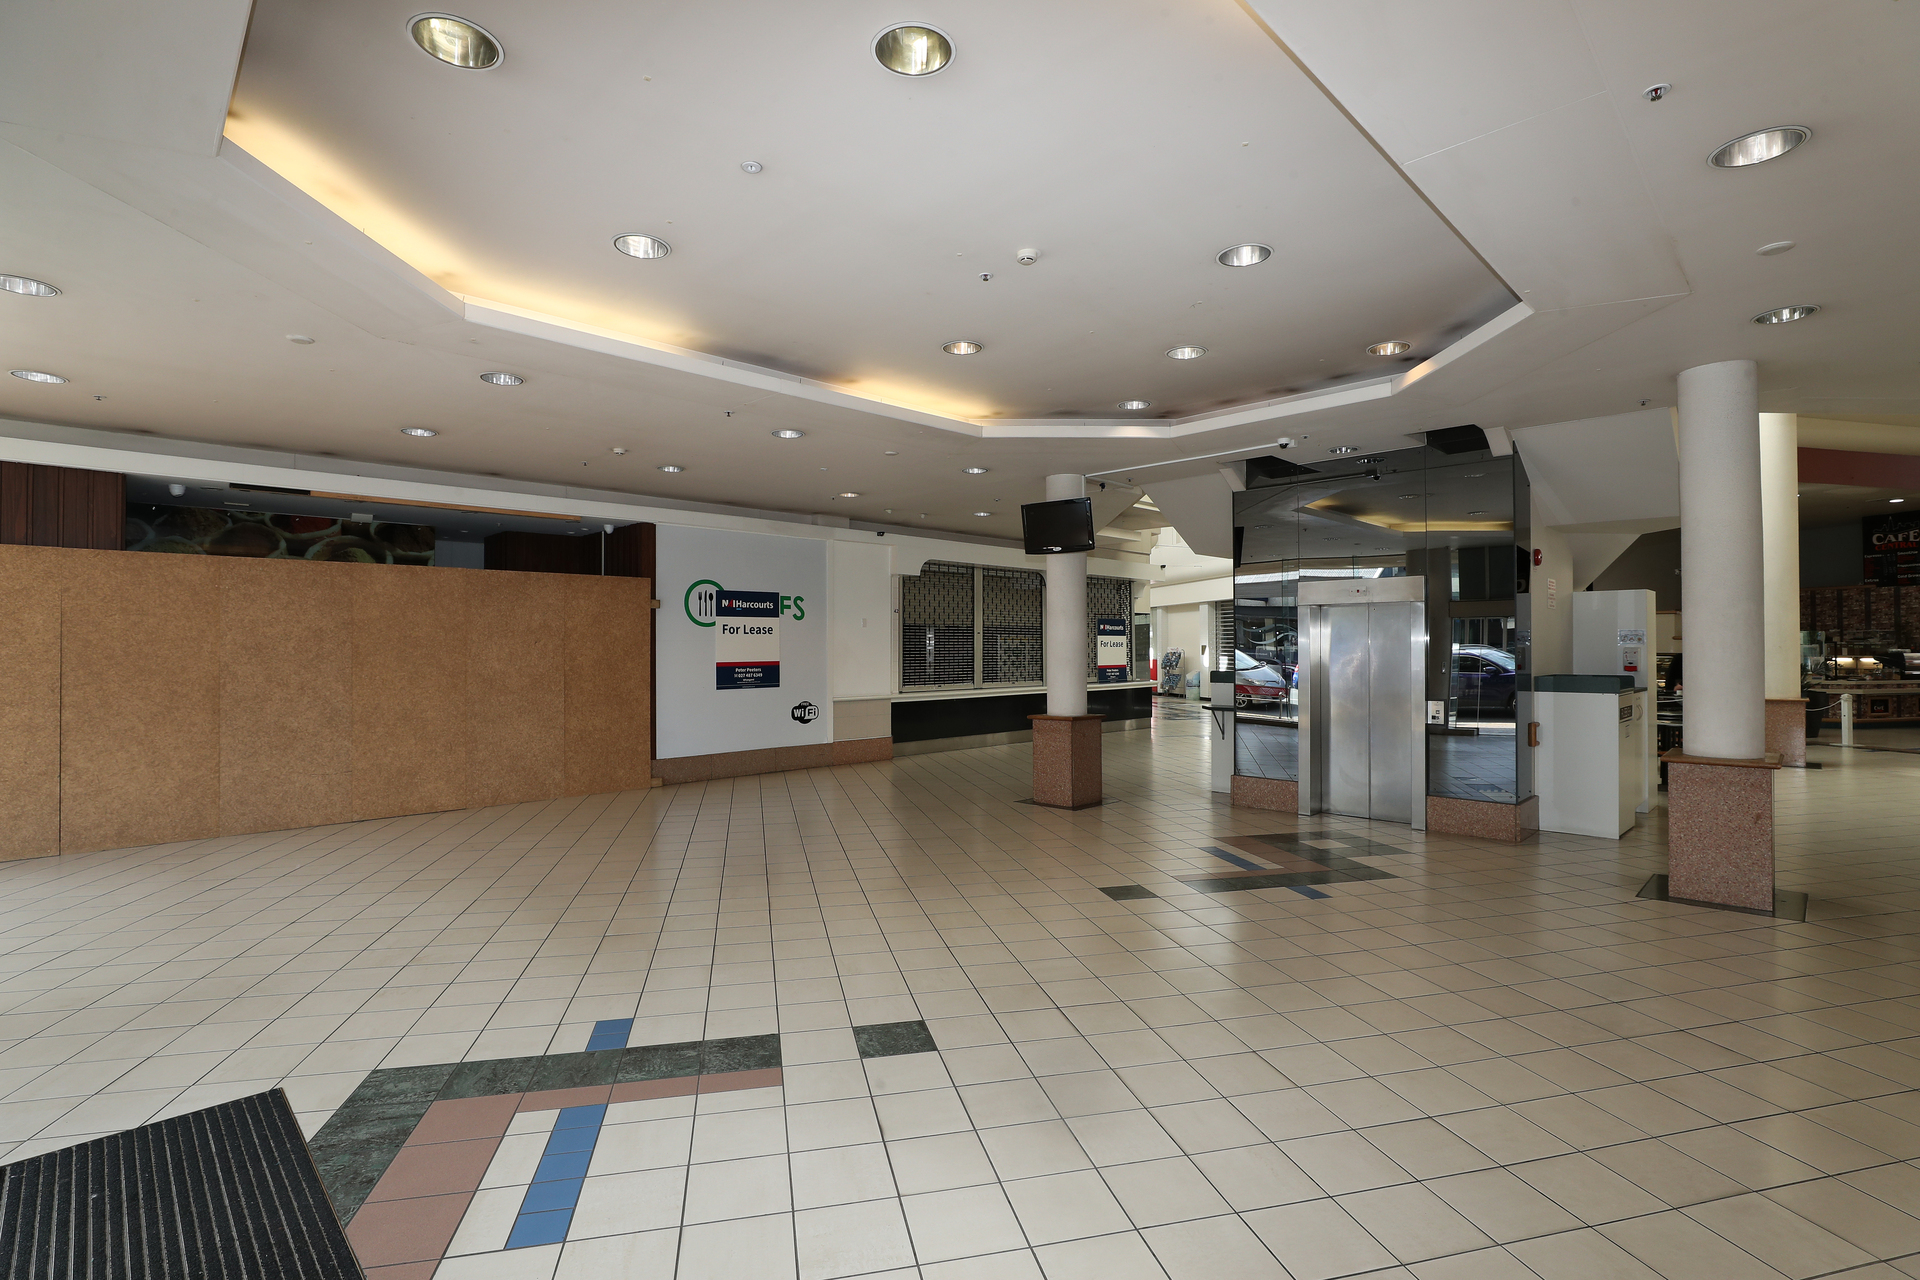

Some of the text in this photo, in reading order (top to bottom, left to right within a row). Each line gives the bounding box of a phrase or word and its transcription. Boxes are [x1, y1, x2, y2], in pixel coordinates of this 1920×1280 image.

[1875, 542, 1919, 551] CENTRAL
[722, 624, 774, 635] For Lease
